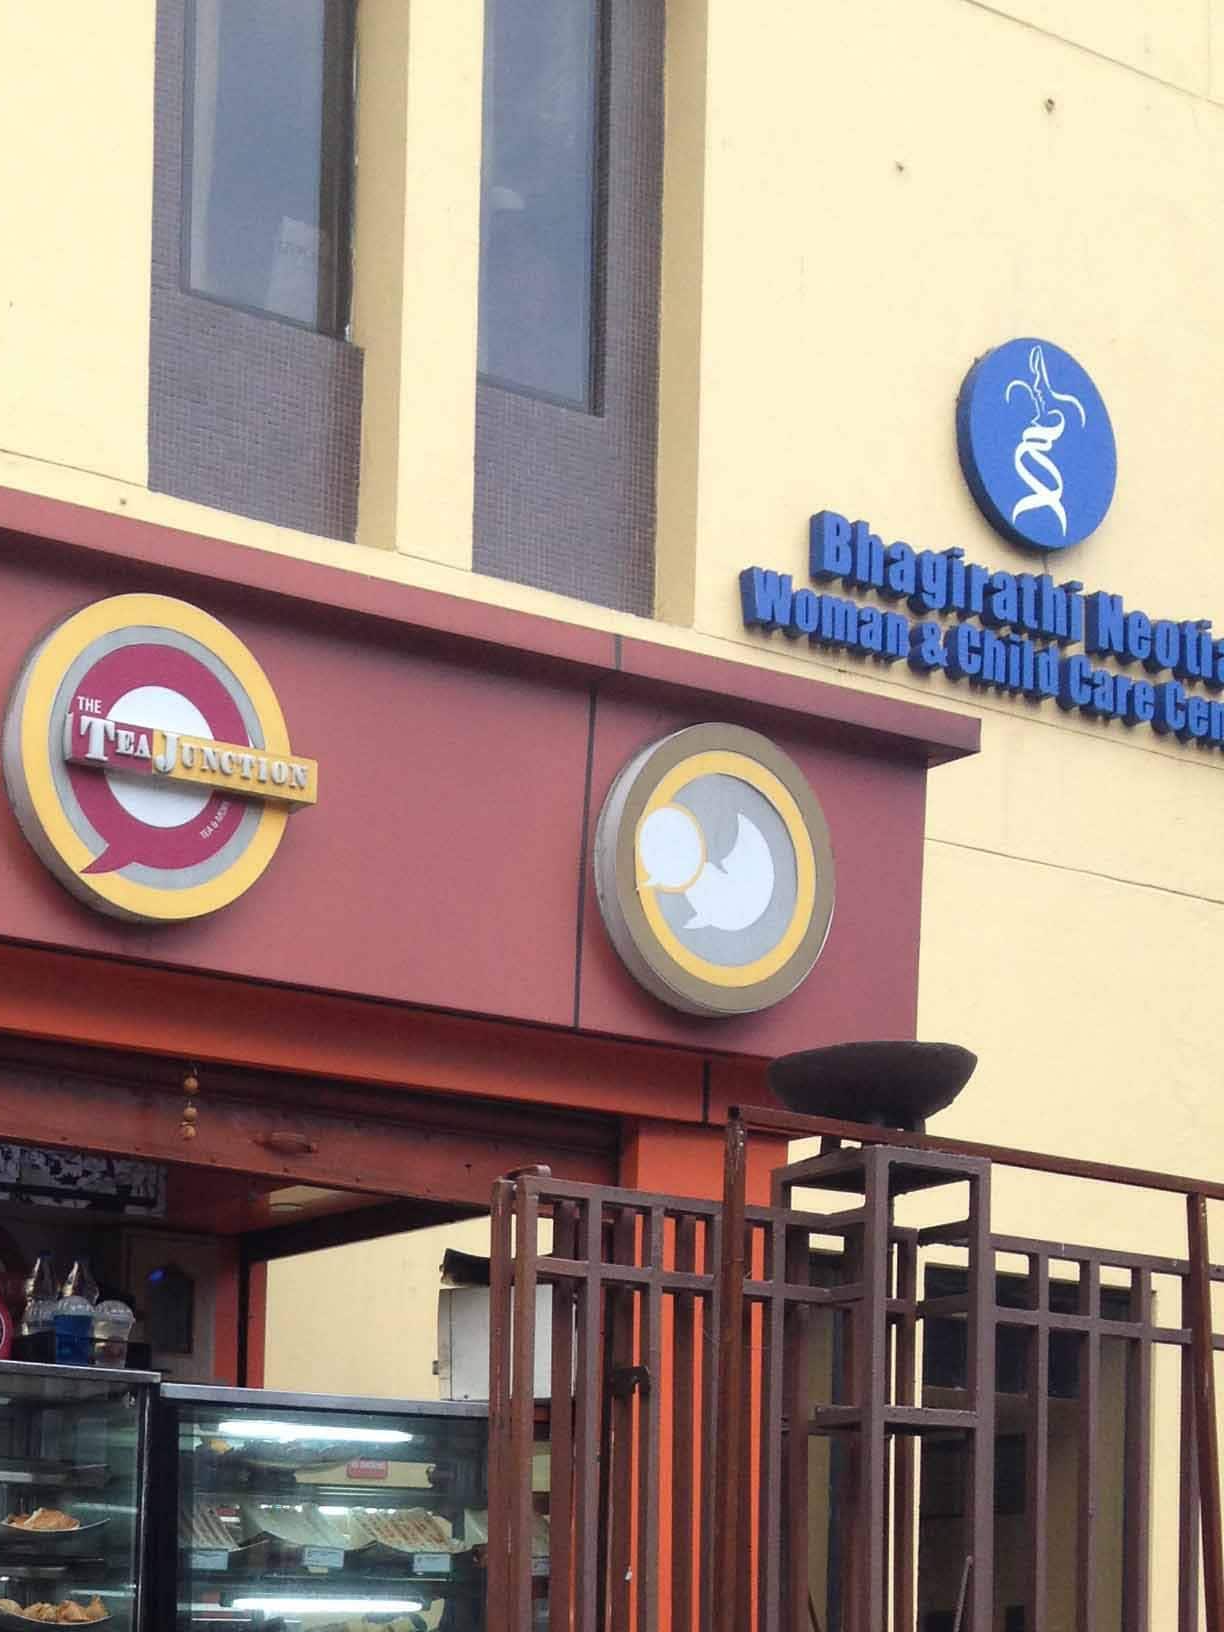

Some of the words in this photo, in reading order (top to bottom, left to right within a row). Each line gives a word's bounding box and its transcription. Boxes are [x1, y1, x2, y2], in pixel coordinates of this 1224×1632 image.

[810, 510, 1084, 642] Bhagirathi
[77, 695, 102, 714] THE
[740, 567, 910, 660] Woman
[914, 621, 948, 672] &
[950, 622, 1060, 698] Child
[1063, 654, 1155, 723] Care
